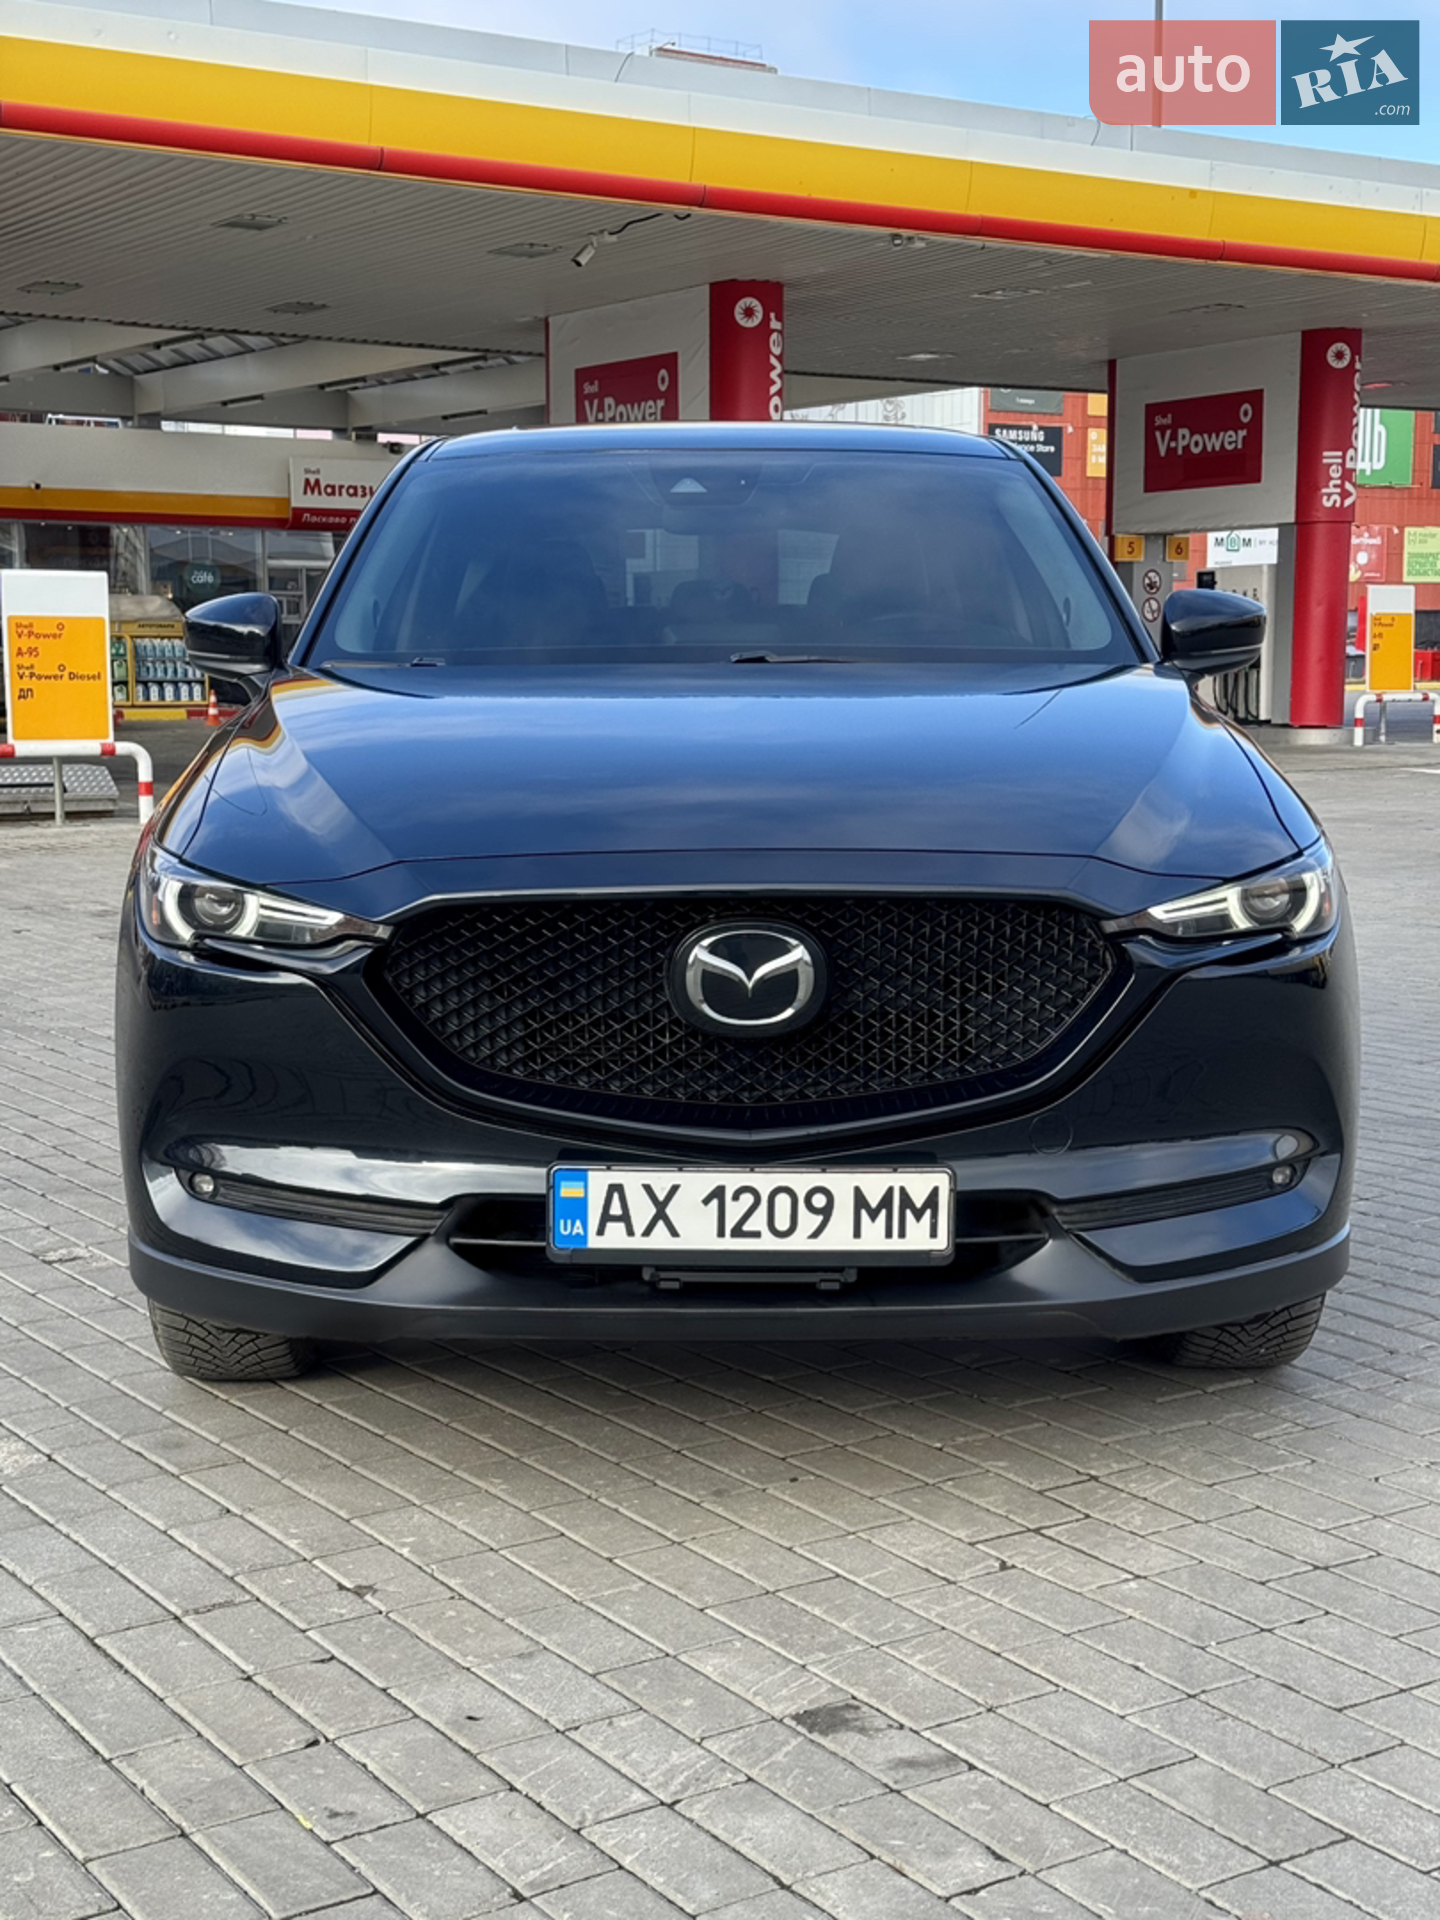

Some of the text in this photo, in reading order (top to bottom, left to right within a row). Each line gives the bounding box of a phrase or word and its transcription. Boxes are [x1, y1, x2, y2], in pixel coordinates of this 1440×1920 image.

[583, 380, 599, 395] Shell
[584, 396, 665, 421] V-Power
[1154, 413, 1172, 426] Shell
[995, 428, 1045, 442] SAMSUNG
[1155, 427, 1248, 457] V-Power
[1036, 444, 1055, 453] Store
[1321, 451, 1343, 508] Shell
[1127, 541, 1135, 554] 5
[1175, 542, 1183, 555] 6
[16, 630, 64, 640] V-Power
[17, 671, 102, 681] V-Power Diesel
[17, 687, 35, 701] ДП
[595, 1183, 940, 1240] AX 1209 MM
[560, 1219, 584, 1236] UA
